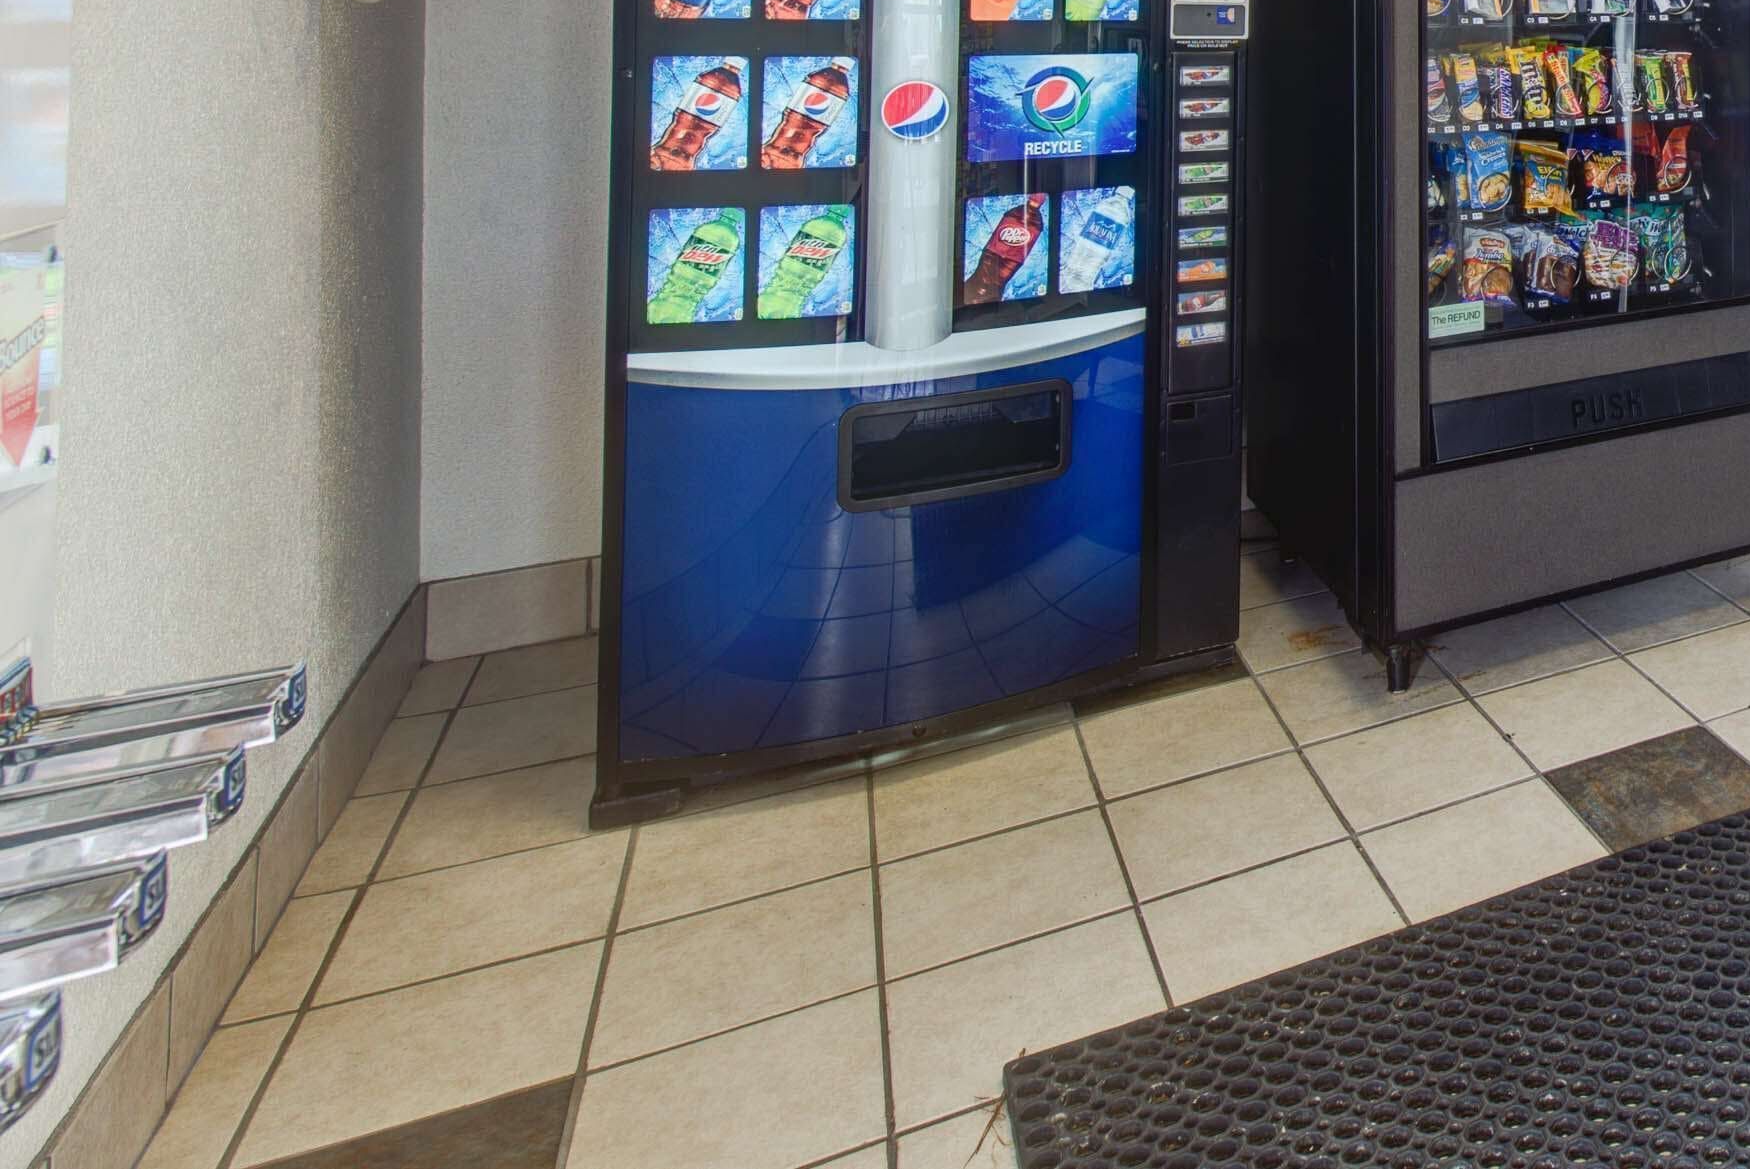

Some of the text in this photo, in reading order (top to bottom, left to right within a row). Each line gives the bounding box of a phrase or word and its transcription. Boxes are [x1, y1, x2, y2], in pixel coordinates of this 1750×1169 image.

[1024, 139, 1083, 156] RECYCLE
[1431, 310, 1481, 325] The REFUND
[1571, 387, 1644, 429] PUSH
